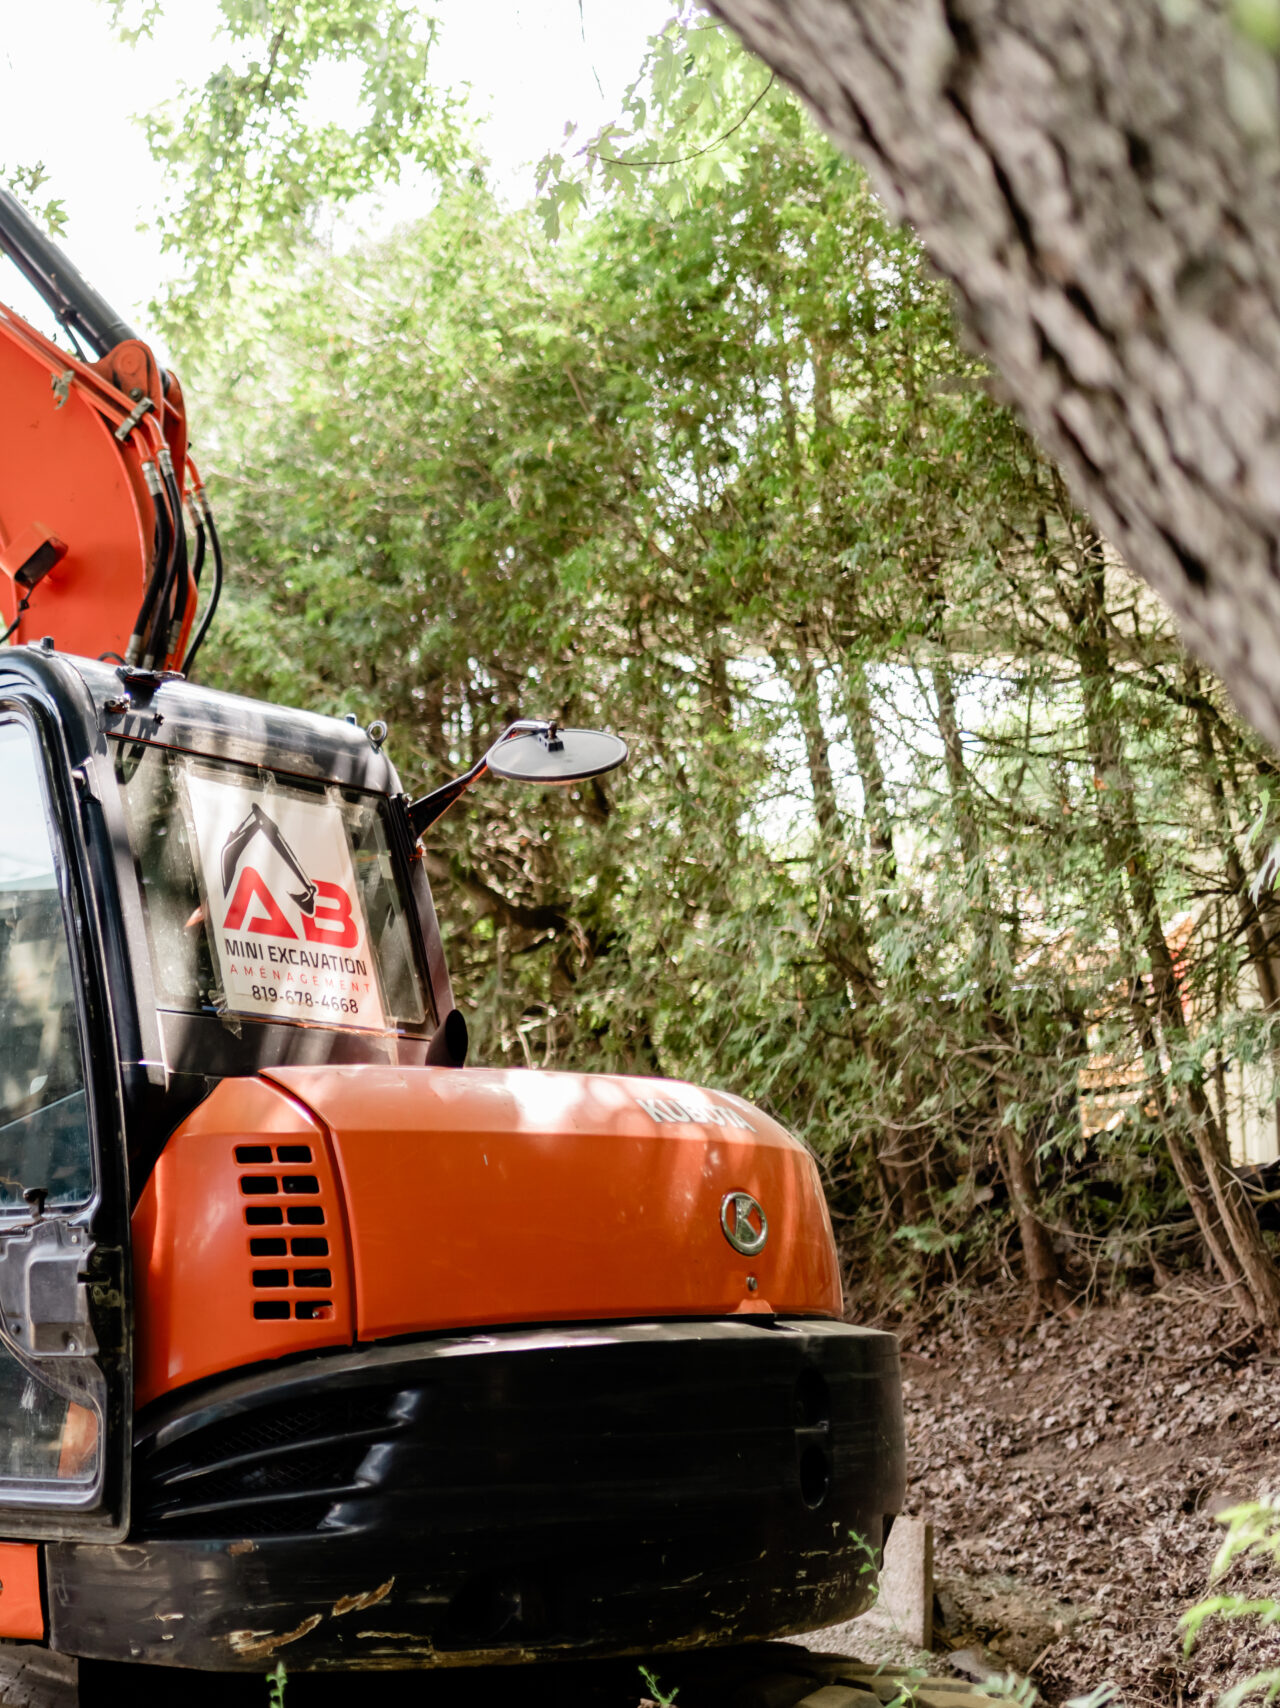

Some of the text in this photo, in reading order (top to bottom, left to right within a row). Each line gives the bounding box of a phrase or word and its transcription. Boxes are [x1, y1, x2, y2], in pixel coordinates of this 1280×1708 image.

[225, 938, 368, 977] MINI EXCAVATION
[251, 984, 360, 1014] 819-678-4668
[634, 1097, 759, 1134] KUBOTA
